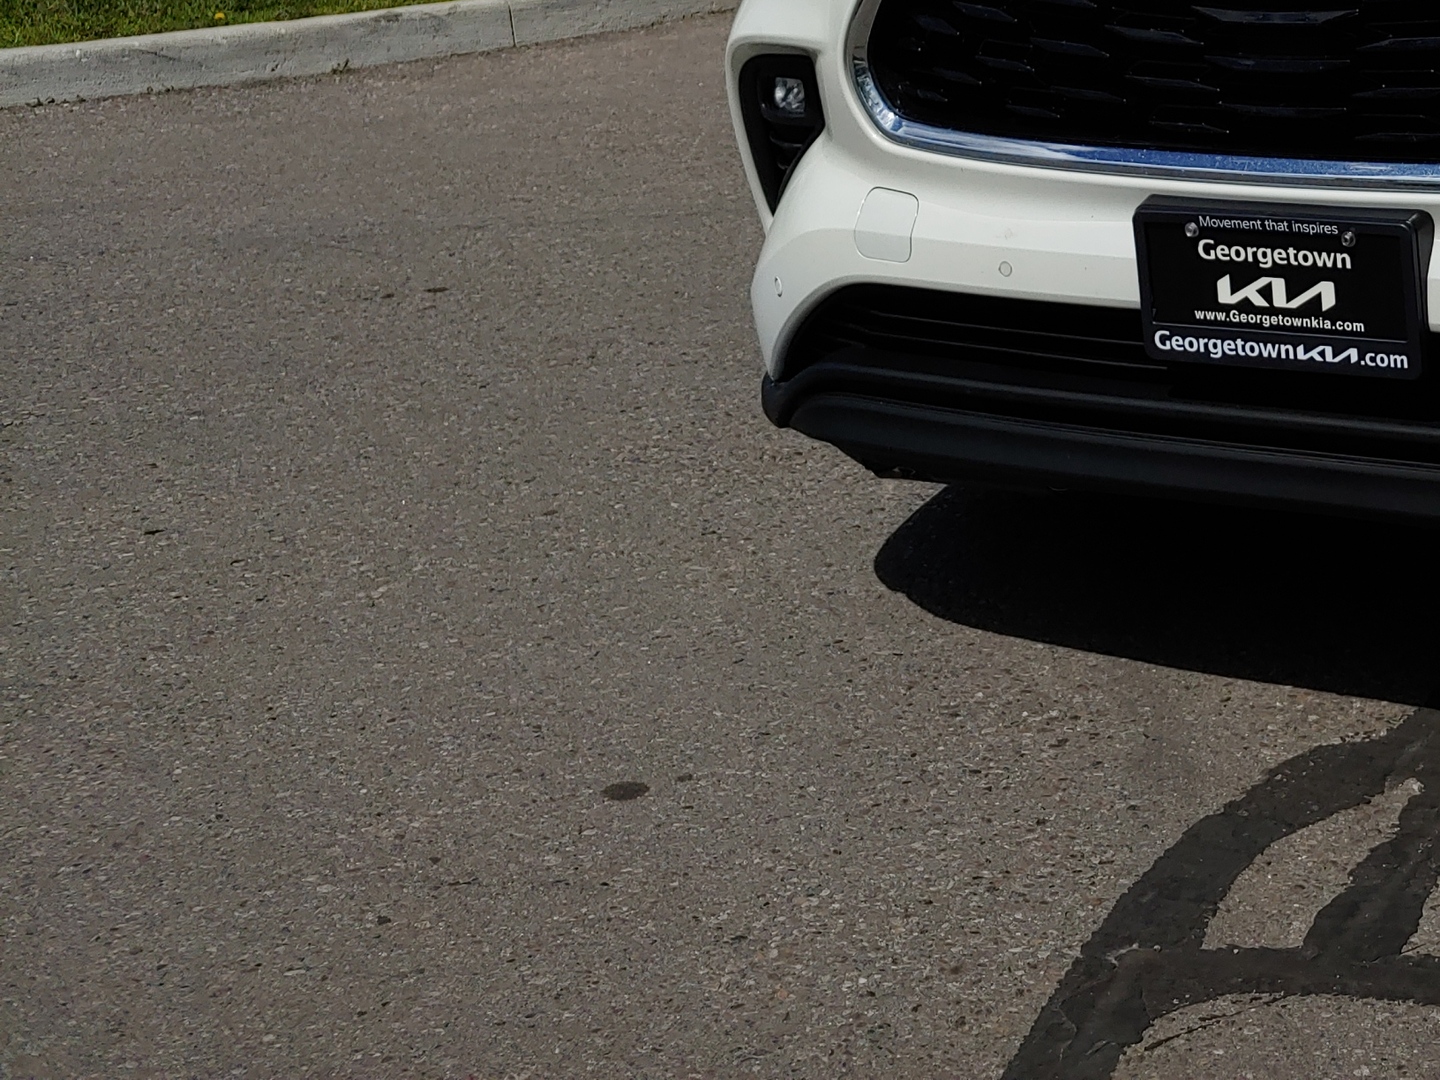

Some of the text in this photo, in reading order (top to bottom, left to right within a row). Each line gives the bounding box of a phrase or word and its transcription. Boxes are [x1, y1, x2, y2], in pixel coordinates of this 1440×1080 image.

[1198, 215, 1339, 236] Movement that inspires
[1197, 239, 1352, 269] Georgetown
[1216, 273, 1337, 312] KIA
[1194, 309, 1365, 333] www.Georgetownkia.com
